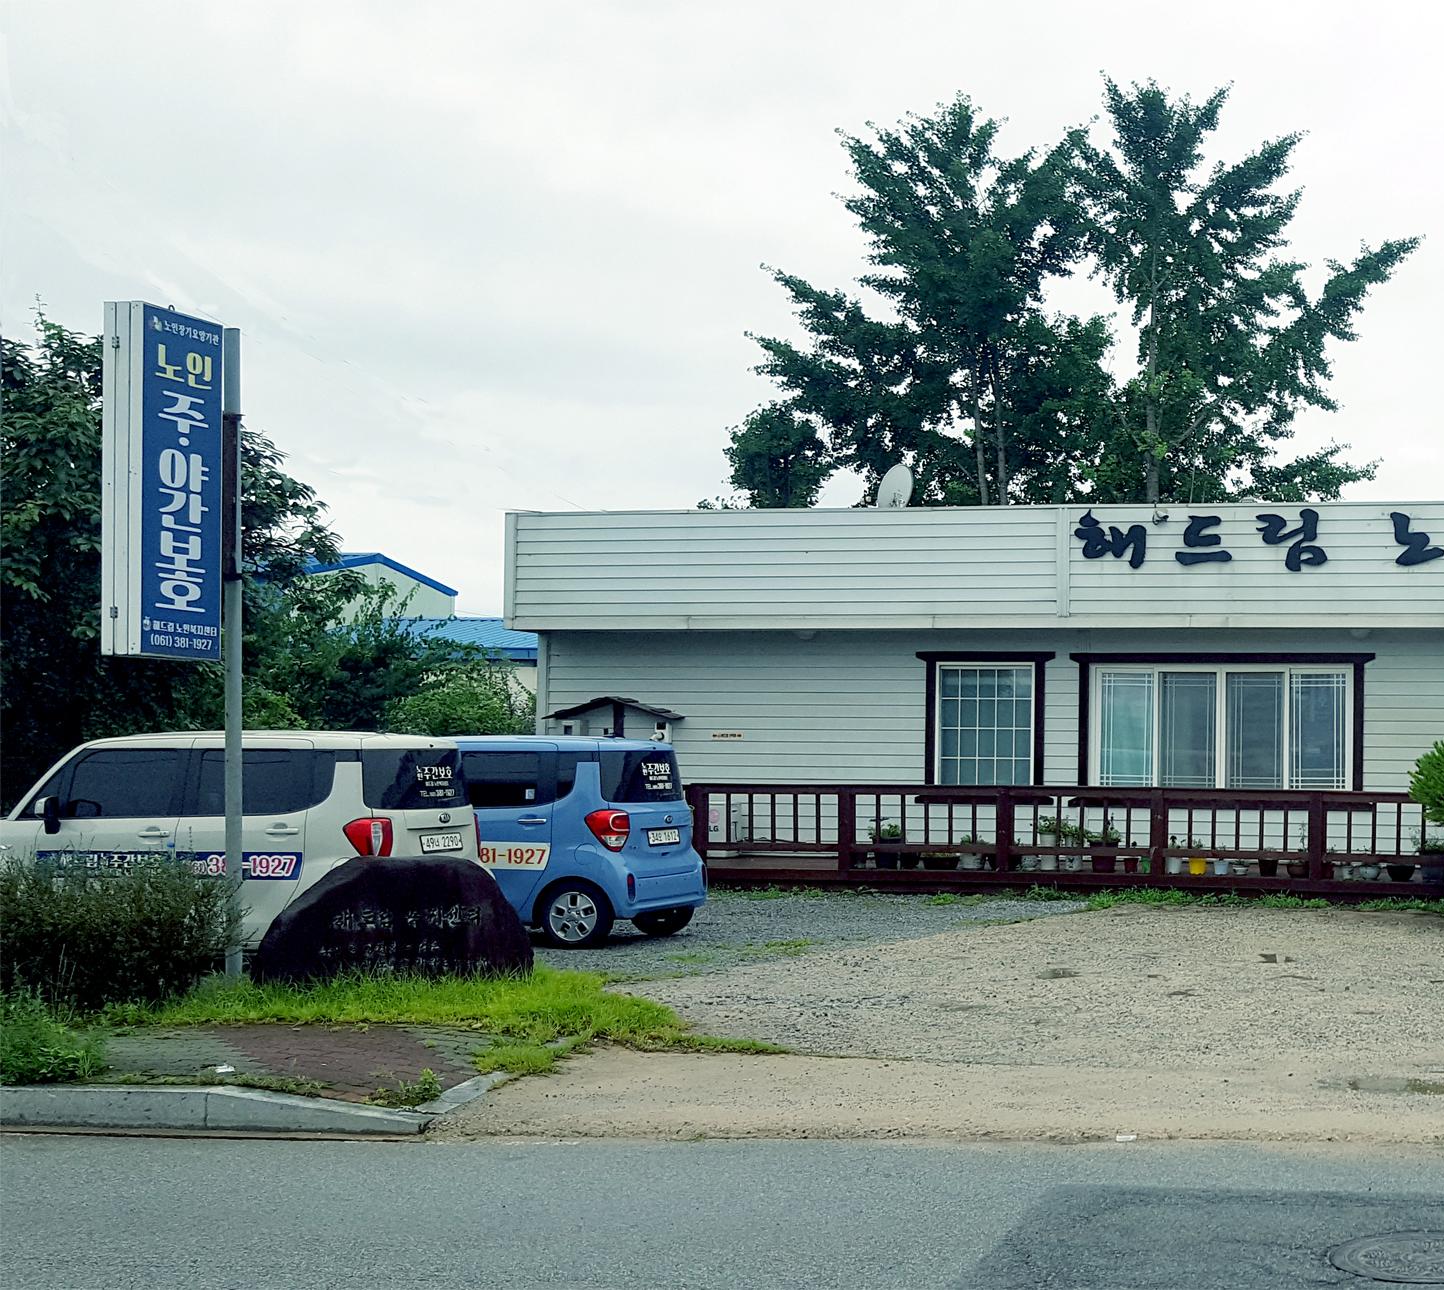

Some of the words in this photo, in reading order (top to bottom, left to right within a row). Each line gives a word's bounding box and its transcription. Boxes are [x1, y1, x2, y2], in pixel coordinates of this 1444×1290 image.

[164, 320, 219, 346] 노인장기요양기관
[155, 343, 212, 390] 노인
[1074, 508, 1328, 572] 해드림
[150, 633, 173, 647] (061)
[174, 637, 213, 650] 381-1927
